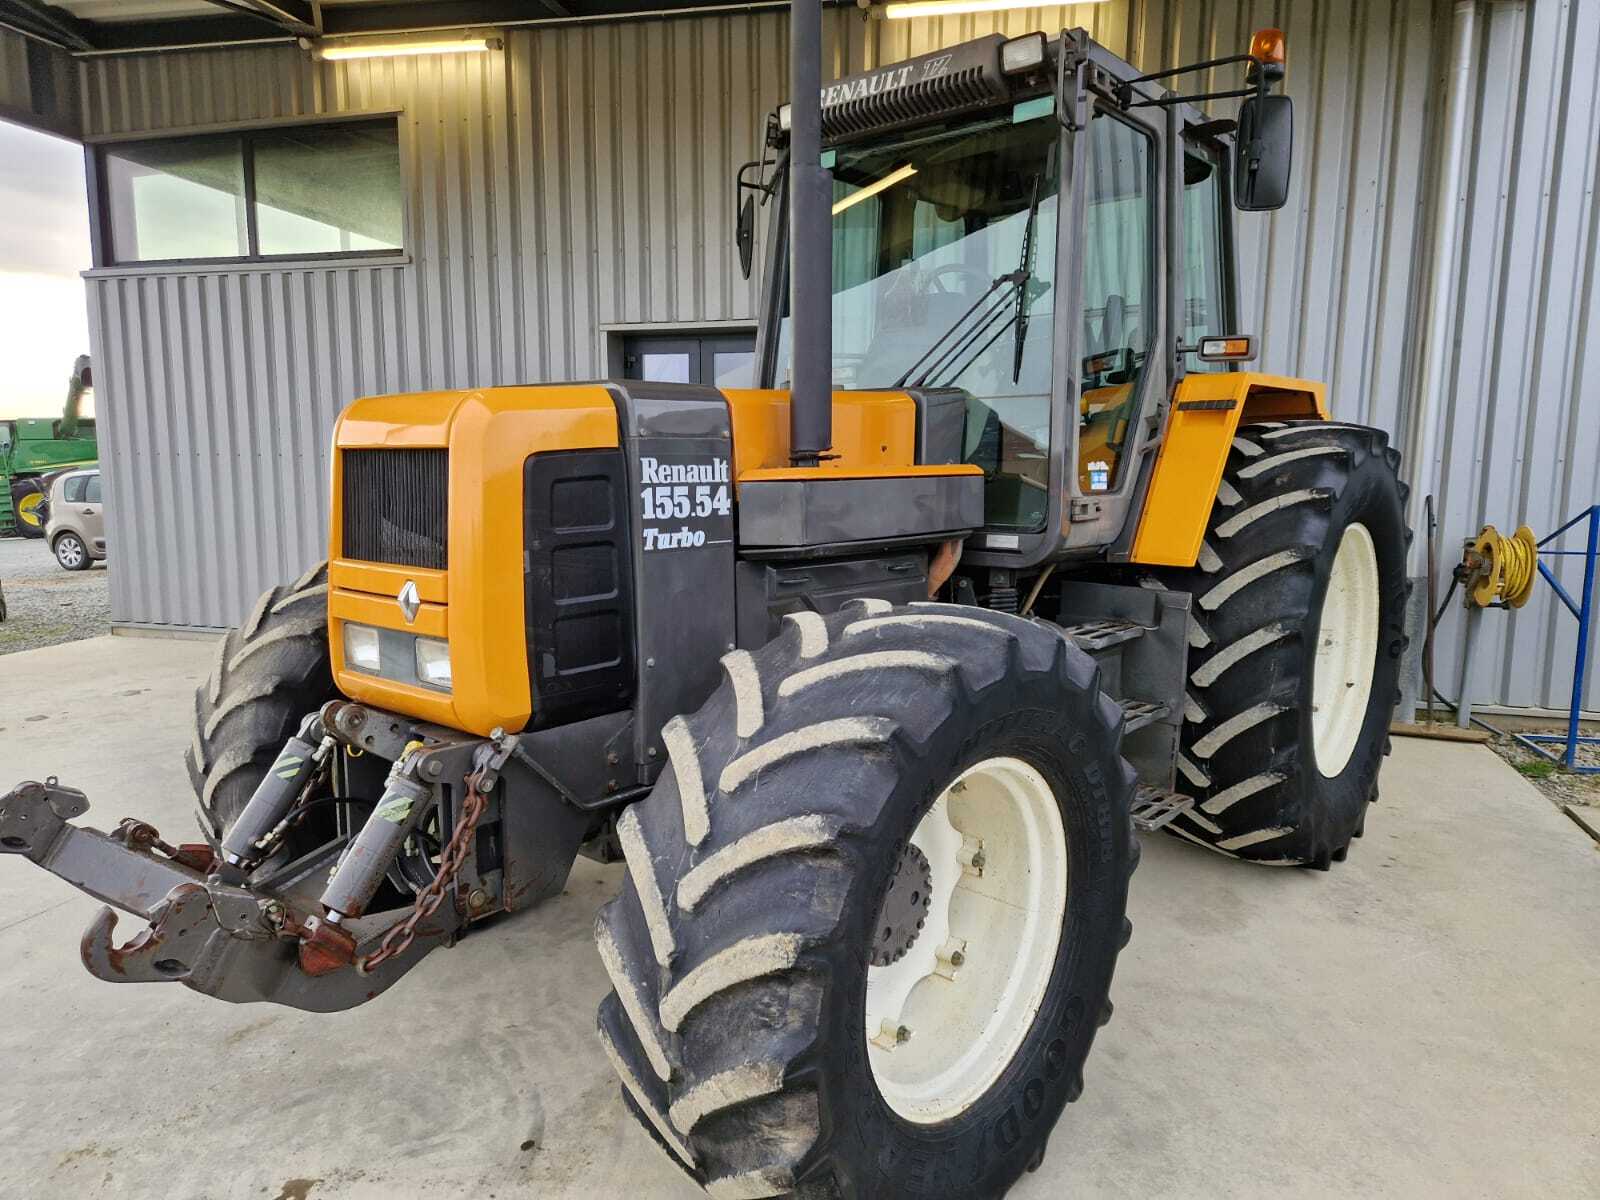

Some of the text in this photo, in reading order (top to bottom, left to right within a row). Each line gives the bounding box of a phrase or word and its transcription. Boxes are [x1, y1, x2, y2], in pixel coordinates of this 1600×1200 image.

[640, 457, 729, 484] Renault
[640, 485, 731, 519] 155.54
[643, 526, 706, 551] Turbo
